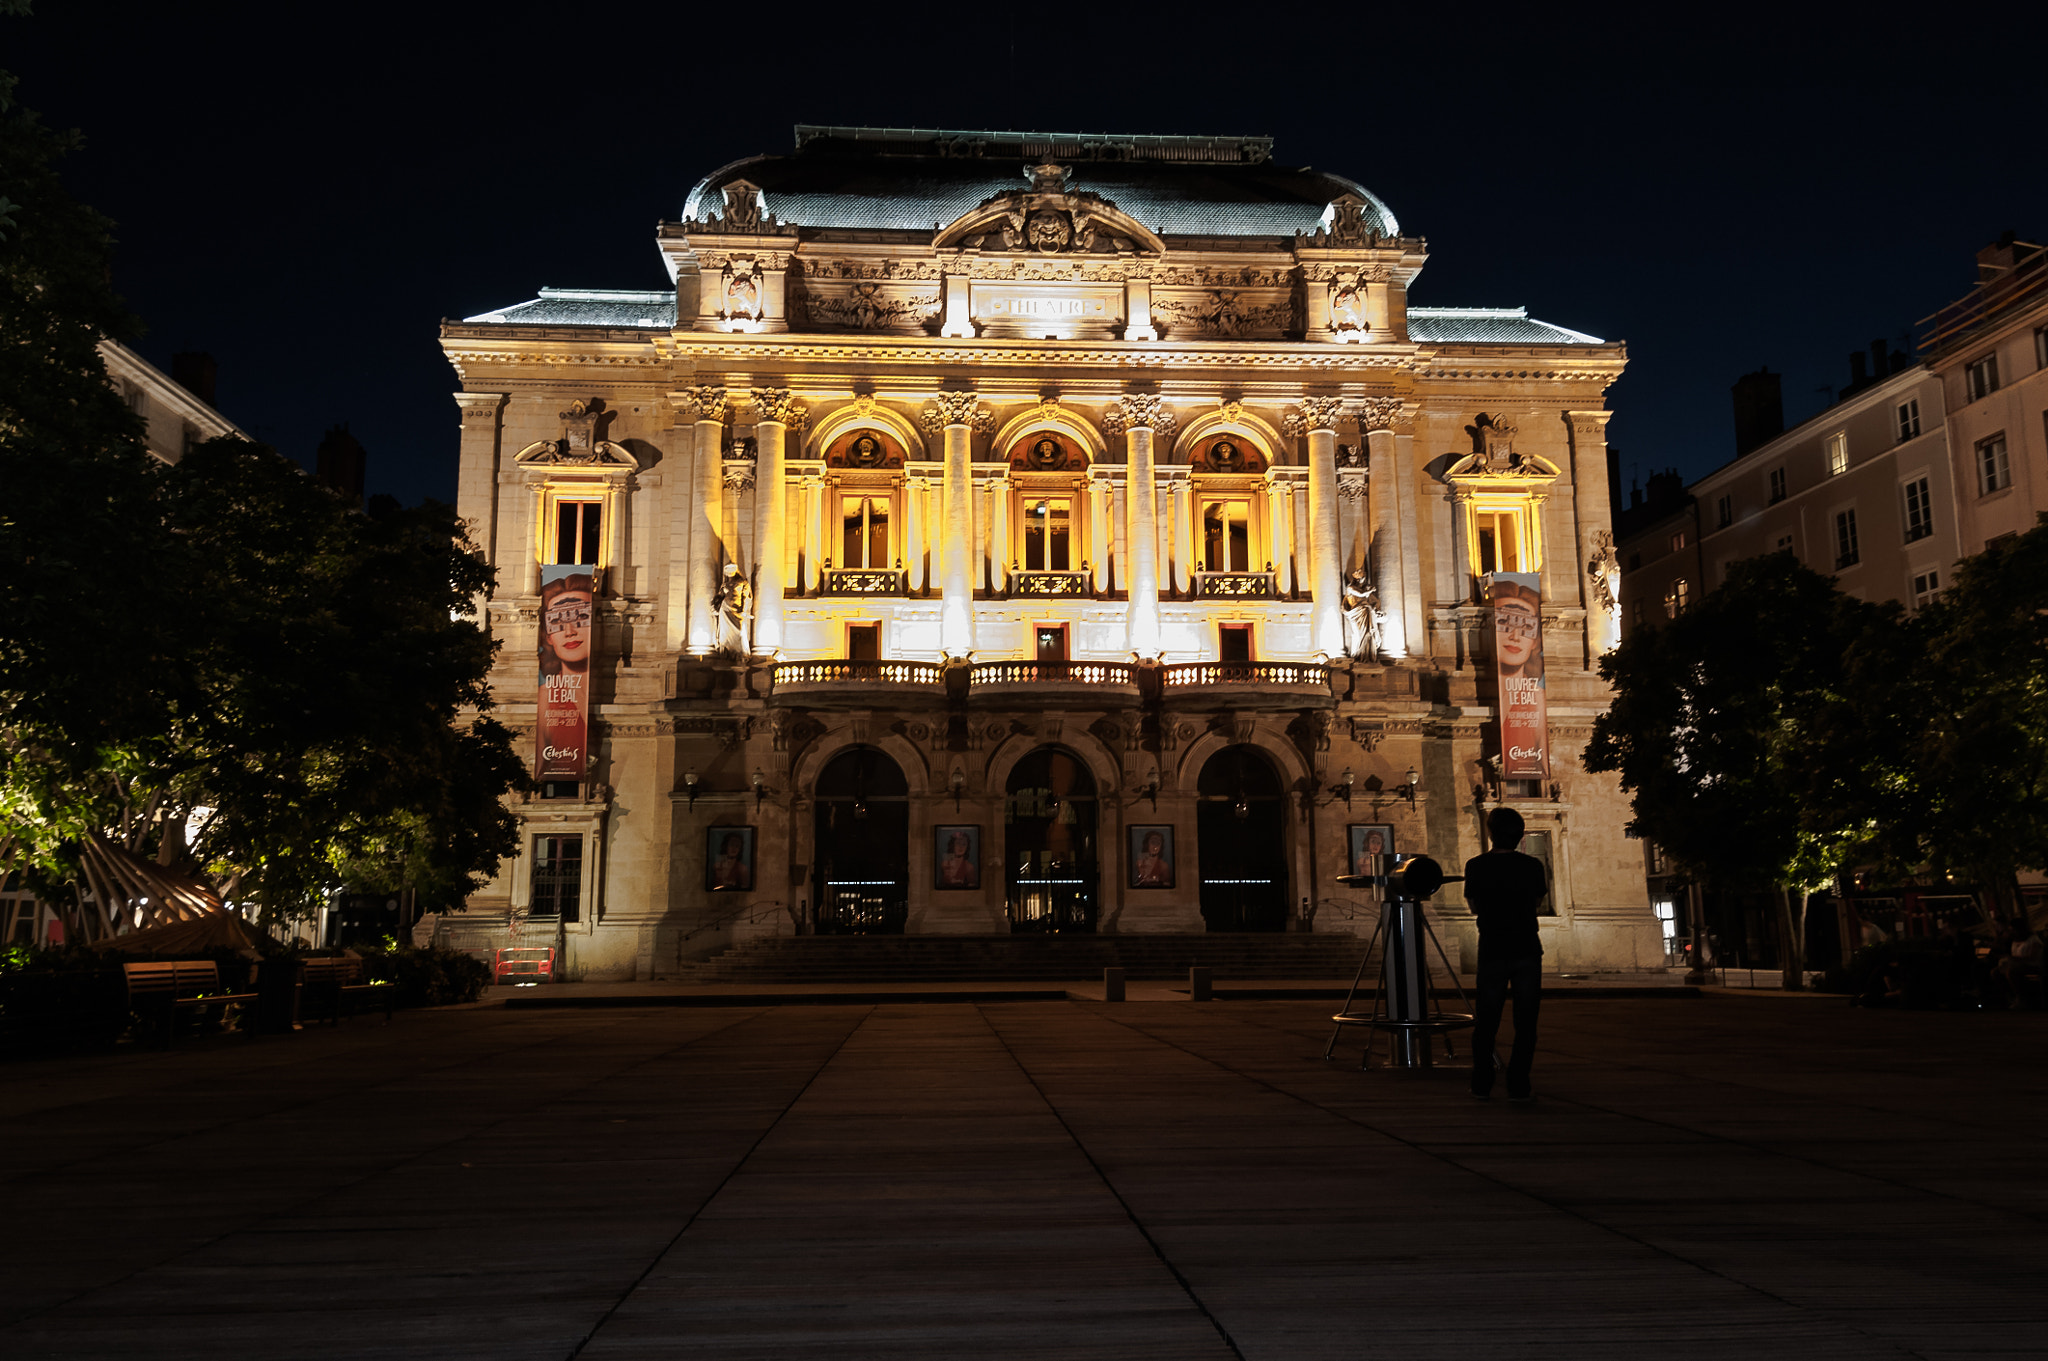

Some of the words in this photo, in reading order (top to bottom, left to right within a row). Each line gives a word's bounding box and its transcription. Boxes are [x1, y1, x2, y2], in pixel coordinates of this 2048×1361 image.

[545, 674, 582, 688] OUVREZ
[1505, 677, 1540, 691] OUVREZ
[548, 689, 559, 703] LE
[561, 689, 578, 703] BAL
[1508, 691, 1520, 705] LE
[1521, 691, 1538, 705] BAL
